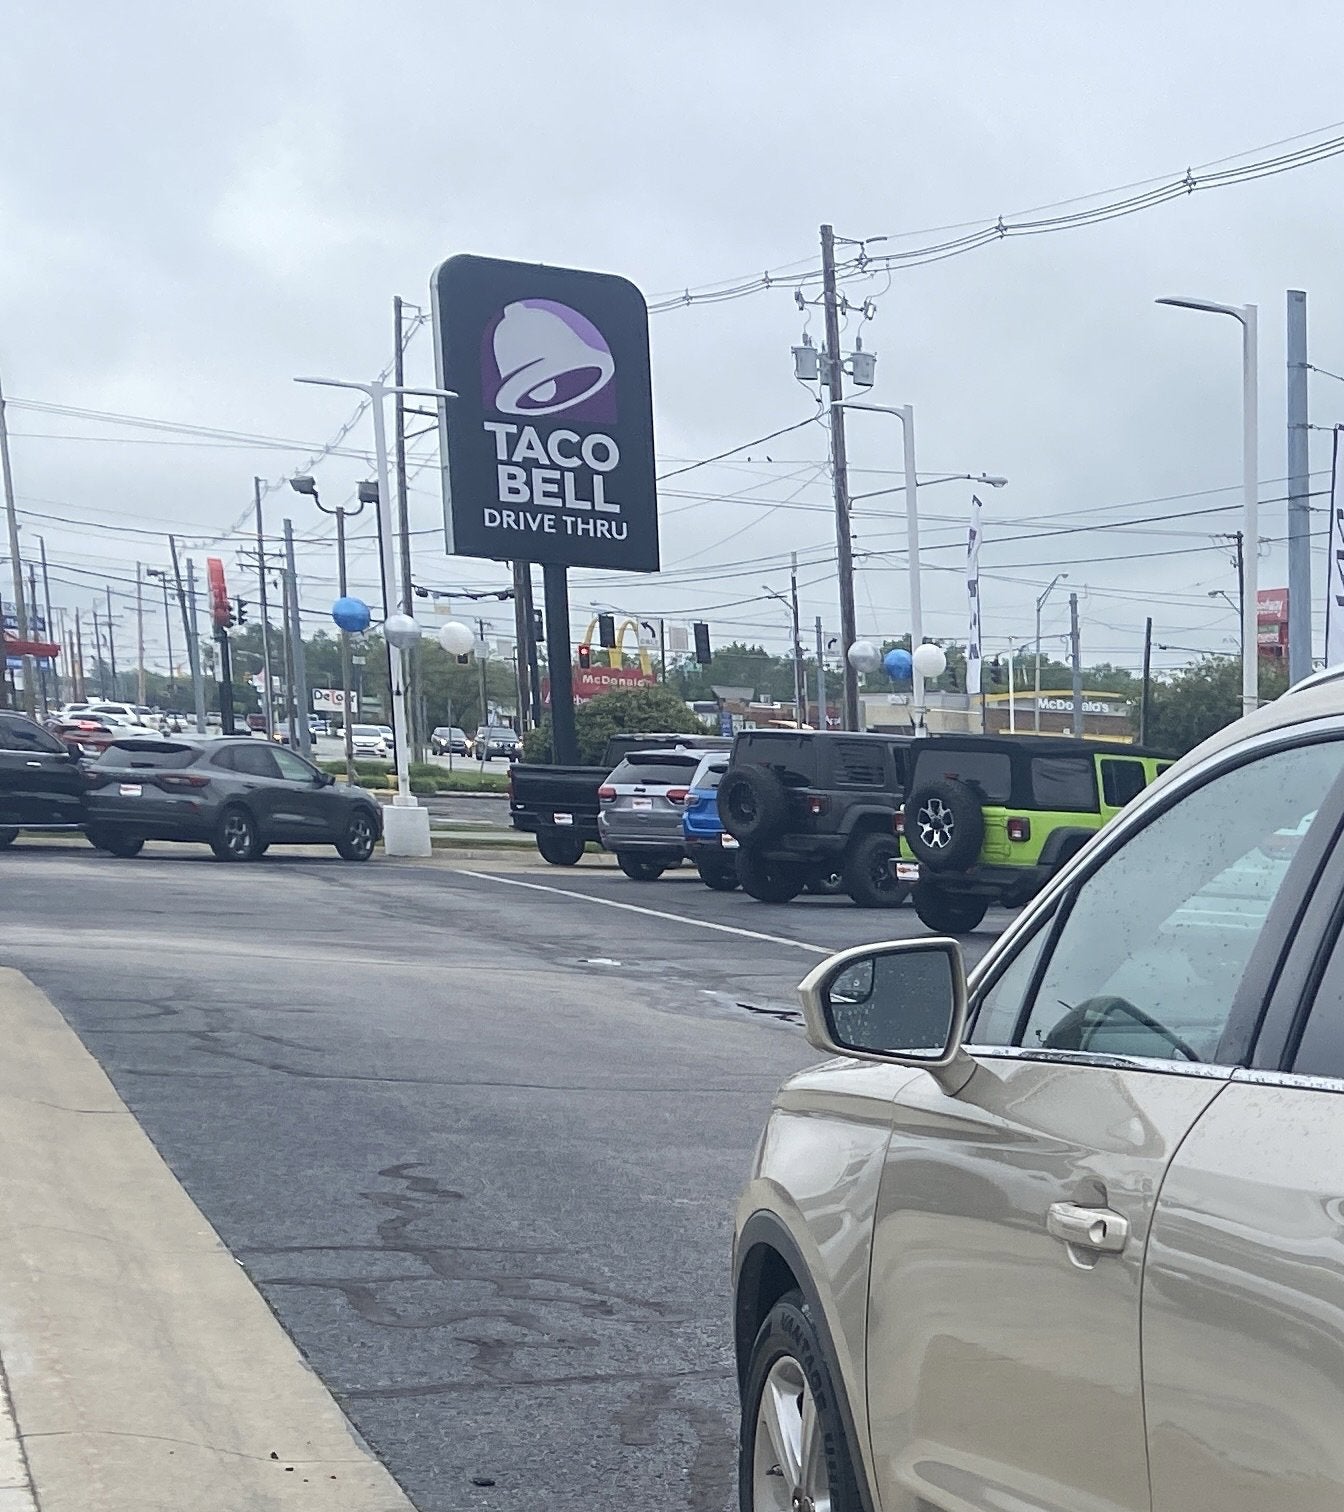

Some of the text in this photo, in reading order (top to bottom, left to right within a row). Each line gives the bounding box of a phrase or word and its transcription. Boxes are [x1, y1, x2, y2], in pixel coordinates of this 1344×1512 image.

[483, 421, 620, 472] TACO
[497, 464, 621, 514] BELL
[483, 507, 628, 541] DRIVE THRU
[1037, 697, 1109, 713] McDoald's
